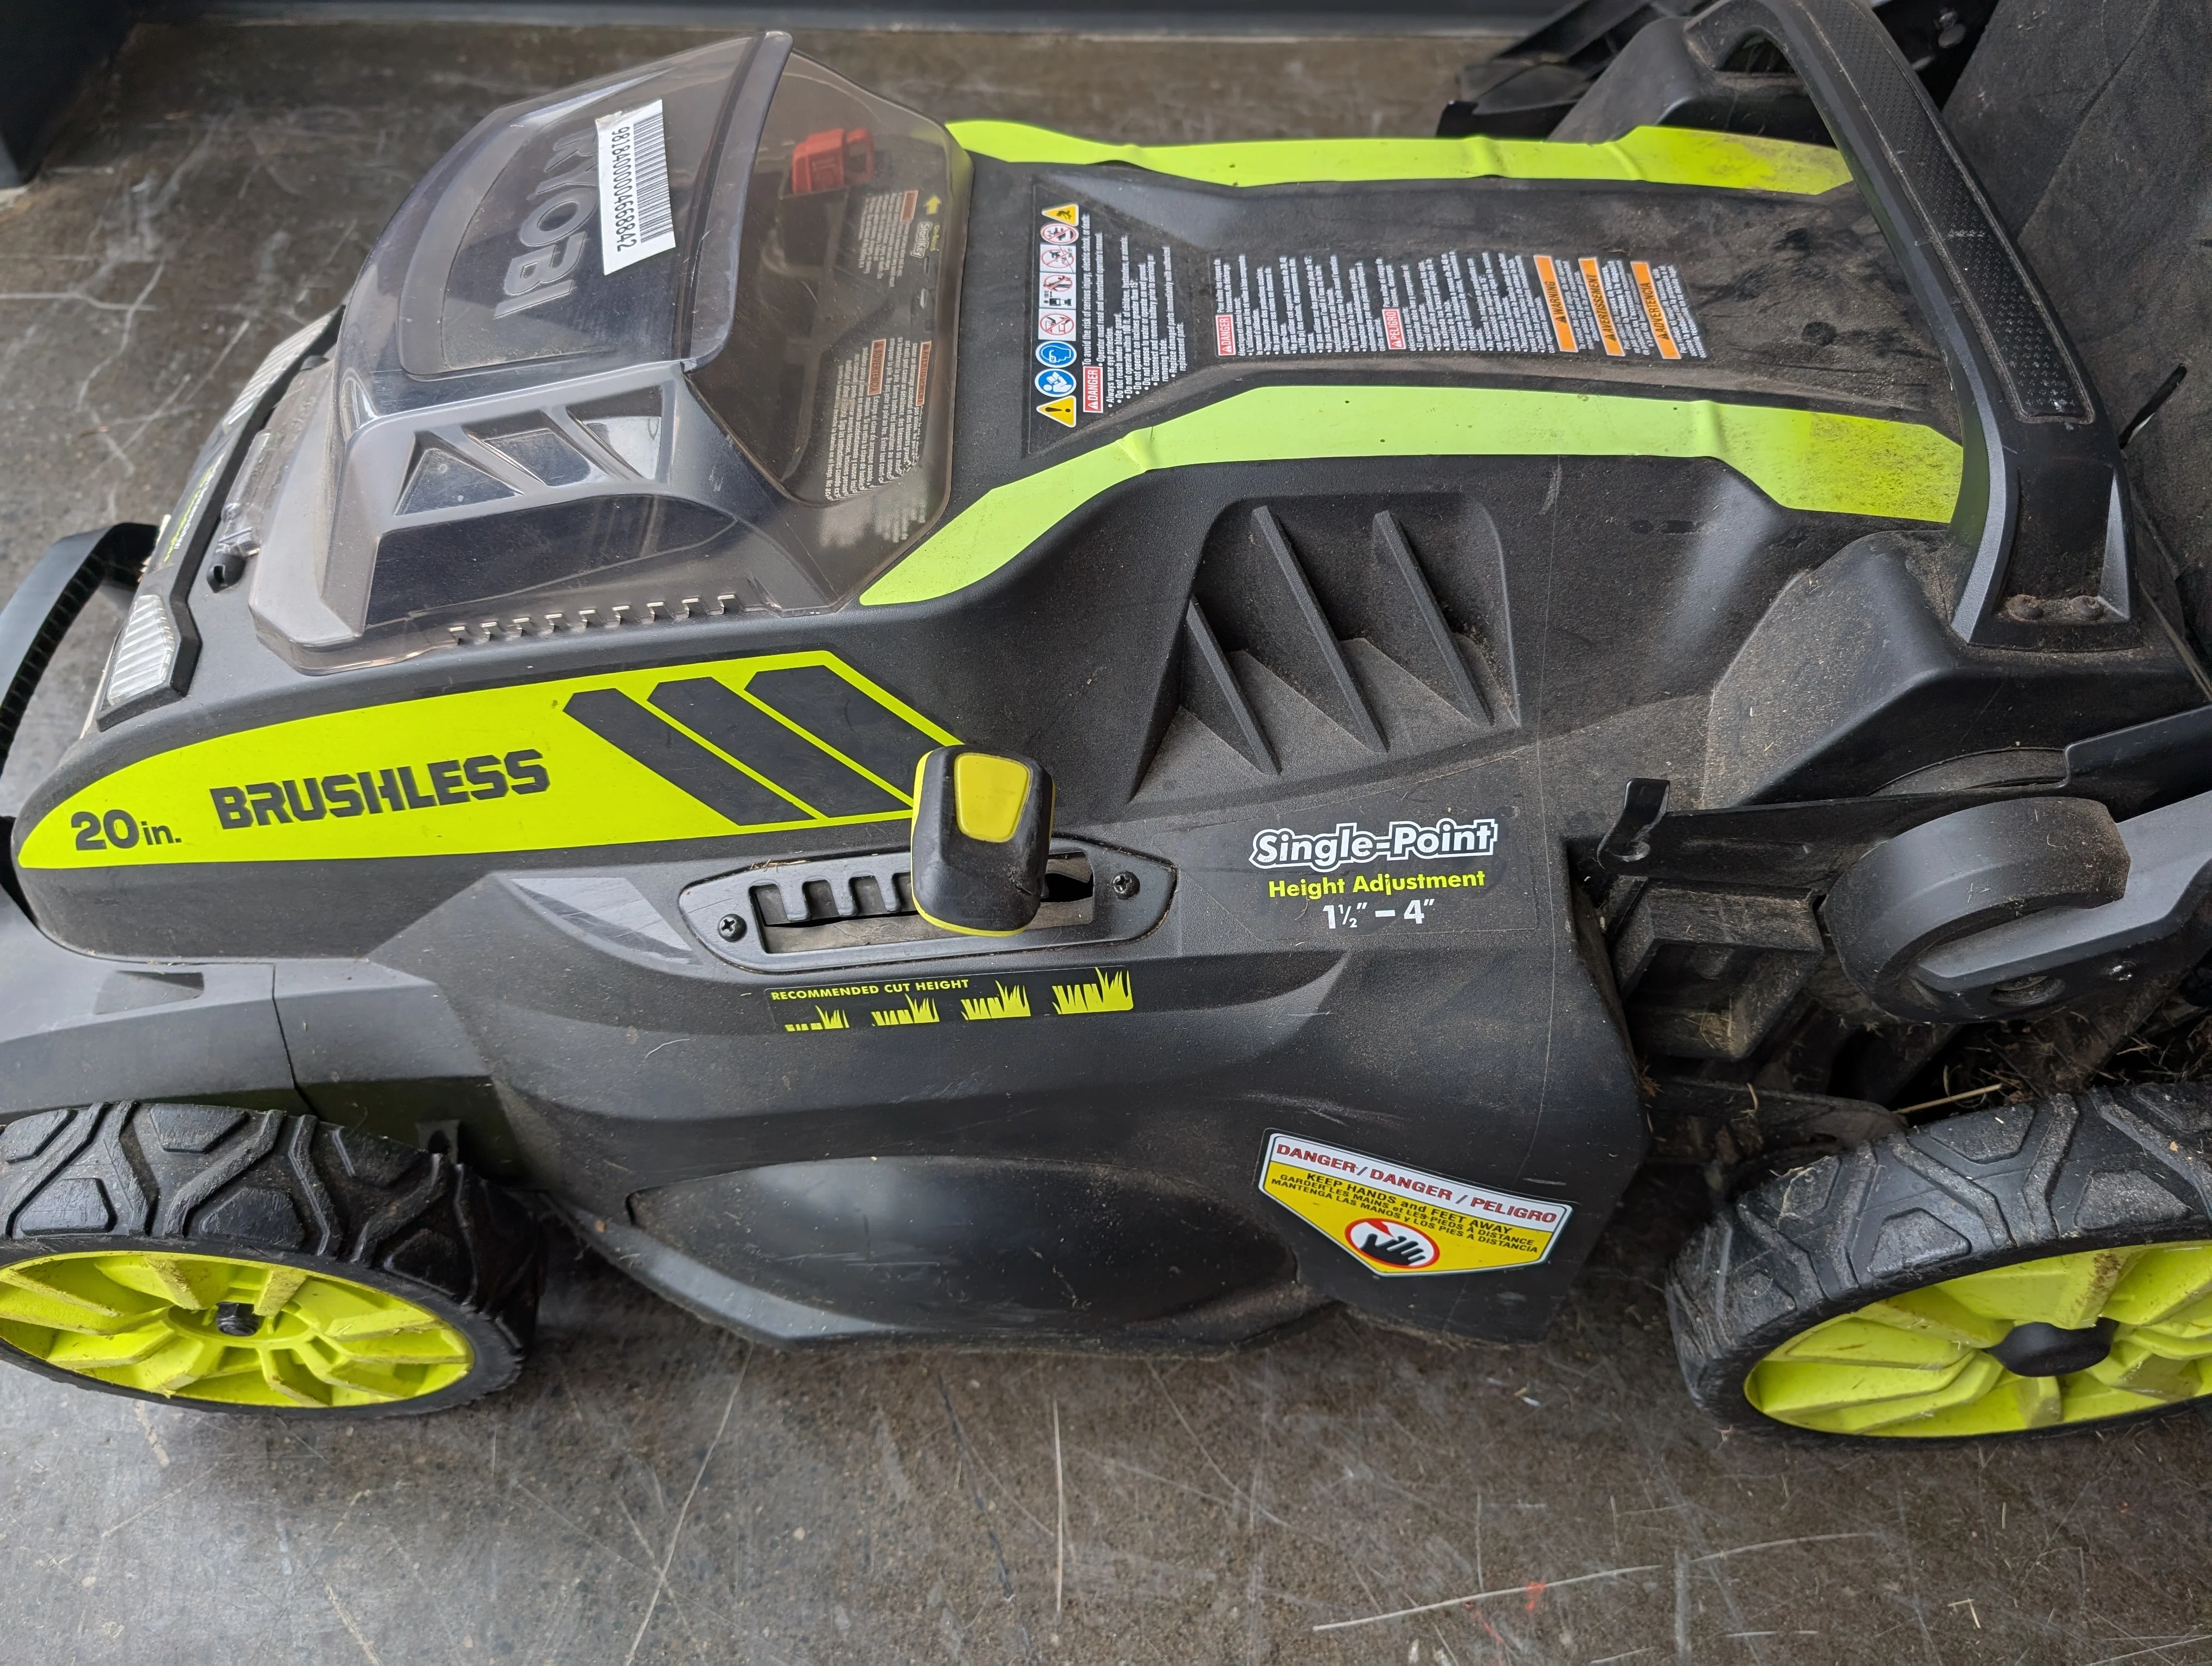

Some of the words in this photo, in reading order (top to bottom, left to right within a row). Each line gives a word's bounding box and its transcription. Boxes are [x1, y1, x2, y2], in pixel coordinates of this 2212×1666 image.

[1082, 273, 1092, 289] injury,
[1138, 282, 1147, 290] wet
[1082, 291, 1090, 310] serious
[1122, 290, 1130, 311] children,
[1130, 290, 1138, 300] than
[1148, 289, 1157, 300] prior
[1545, 281, 1564, 315] WARNING
[1586, 273, 1613, 333] AVERTISSEMENT
[1130, 302, 1140, 319] greater
[1139, 298, 1149, 317] operate
[1148, 302, 1158, 319] battery
[1640, 282, 1666, 332] ADVERTENCIA
[1082, 318, 1090, 329] risk
[1096, 312, 1104, 323] read
[1114, 313, 1123, 329] guard.
[1166, 313, 1175, 325] parts
[1386, 312, 1400, 340] PELIGRO
[1082, 330, 1091, 339] the
[1114, 330, 1122, 345] blade
[1131, 320, 1140, 341] inclines
[1140, 325, 1148, 339] water
[1167, 326, 1177, 350] damaged
[1176, 323, 1185, 337] parts.
[1219, 318, 1231, 345] DANGER
[1082, 341, 1091, 357] avoid
[1096, 339, 1106, 362] Operator
[1105, 326, 1115, 355] protection.
[1123, 336, 1131, 352] within
[1150, 341, 1158, 350] and
[1159, 338, 1167, 355] blade.
[1114, 346, 1122, 361] under
[1132, 350, 1142, 370] operate
[1142, 348, 1151, 366] expose
[1168, 351, 1178, 373] Replace
[1176, 338, 1186, 371] replacement
[1115, 363, 1123, 379] reach
[1123, 354, 1133, 374] operate
[1142, 368, 1150, 376] not
[1150, 351, 1159, 381] Disconnect
[1159, 356, 1169, 381] removing
[1088, 369, 1098, 401] DANGER
[1124, 376, 1132, 385] not
[1106, 382, 1116, 403] Always
[210, 748, 551, 830] BRUSHLESS
[1249, 818, 1499, 873] Single-Point
[1269, 877, 1345, 900] Height
[1353, 870, 1486, 896] Adjustment
[771, 985, 879, 1000] RECOMMENDED
[884, 983, 910, 993] CUT
[915, 979, 969, 991] HEIGHT
[1307, 1172, 1342, 1187] KEEP
[1346, 1184, 1397, 1204] HANDS
[1400, 1201, 1427, 1213] and
[1431, 1208, 1467, 1223] FEET
[1469, 1220, 1513, 1234] AWAY
[1369, 1168, 1452, 1201] DANGER
[1470, 1197, 1557, 1223] PELIGRO
[1271, 1178, 1333, 1199] MANTENGA
[1335, 1196, 1356, 1206] LAS
[1360, 1202, 1401, 1219] MANOS
[1413, 1219, 1435, 1229] LOS
[1438, 1226, 1464, 1236] PIES
[1478, 1236, 1538, 1253] DISTANCIA
[1280, 1174, 1326, 1190] GARDER
[1329, 1187, 1349, 1197] LES
[1352, 1194, 1389, 1208] MAINS
[1406, 1210, 1427, 1220] LES
[1430, 1215, 1464, 1229] PIEDS
[1478, 1229, 1535, 1245] DISTANCE
